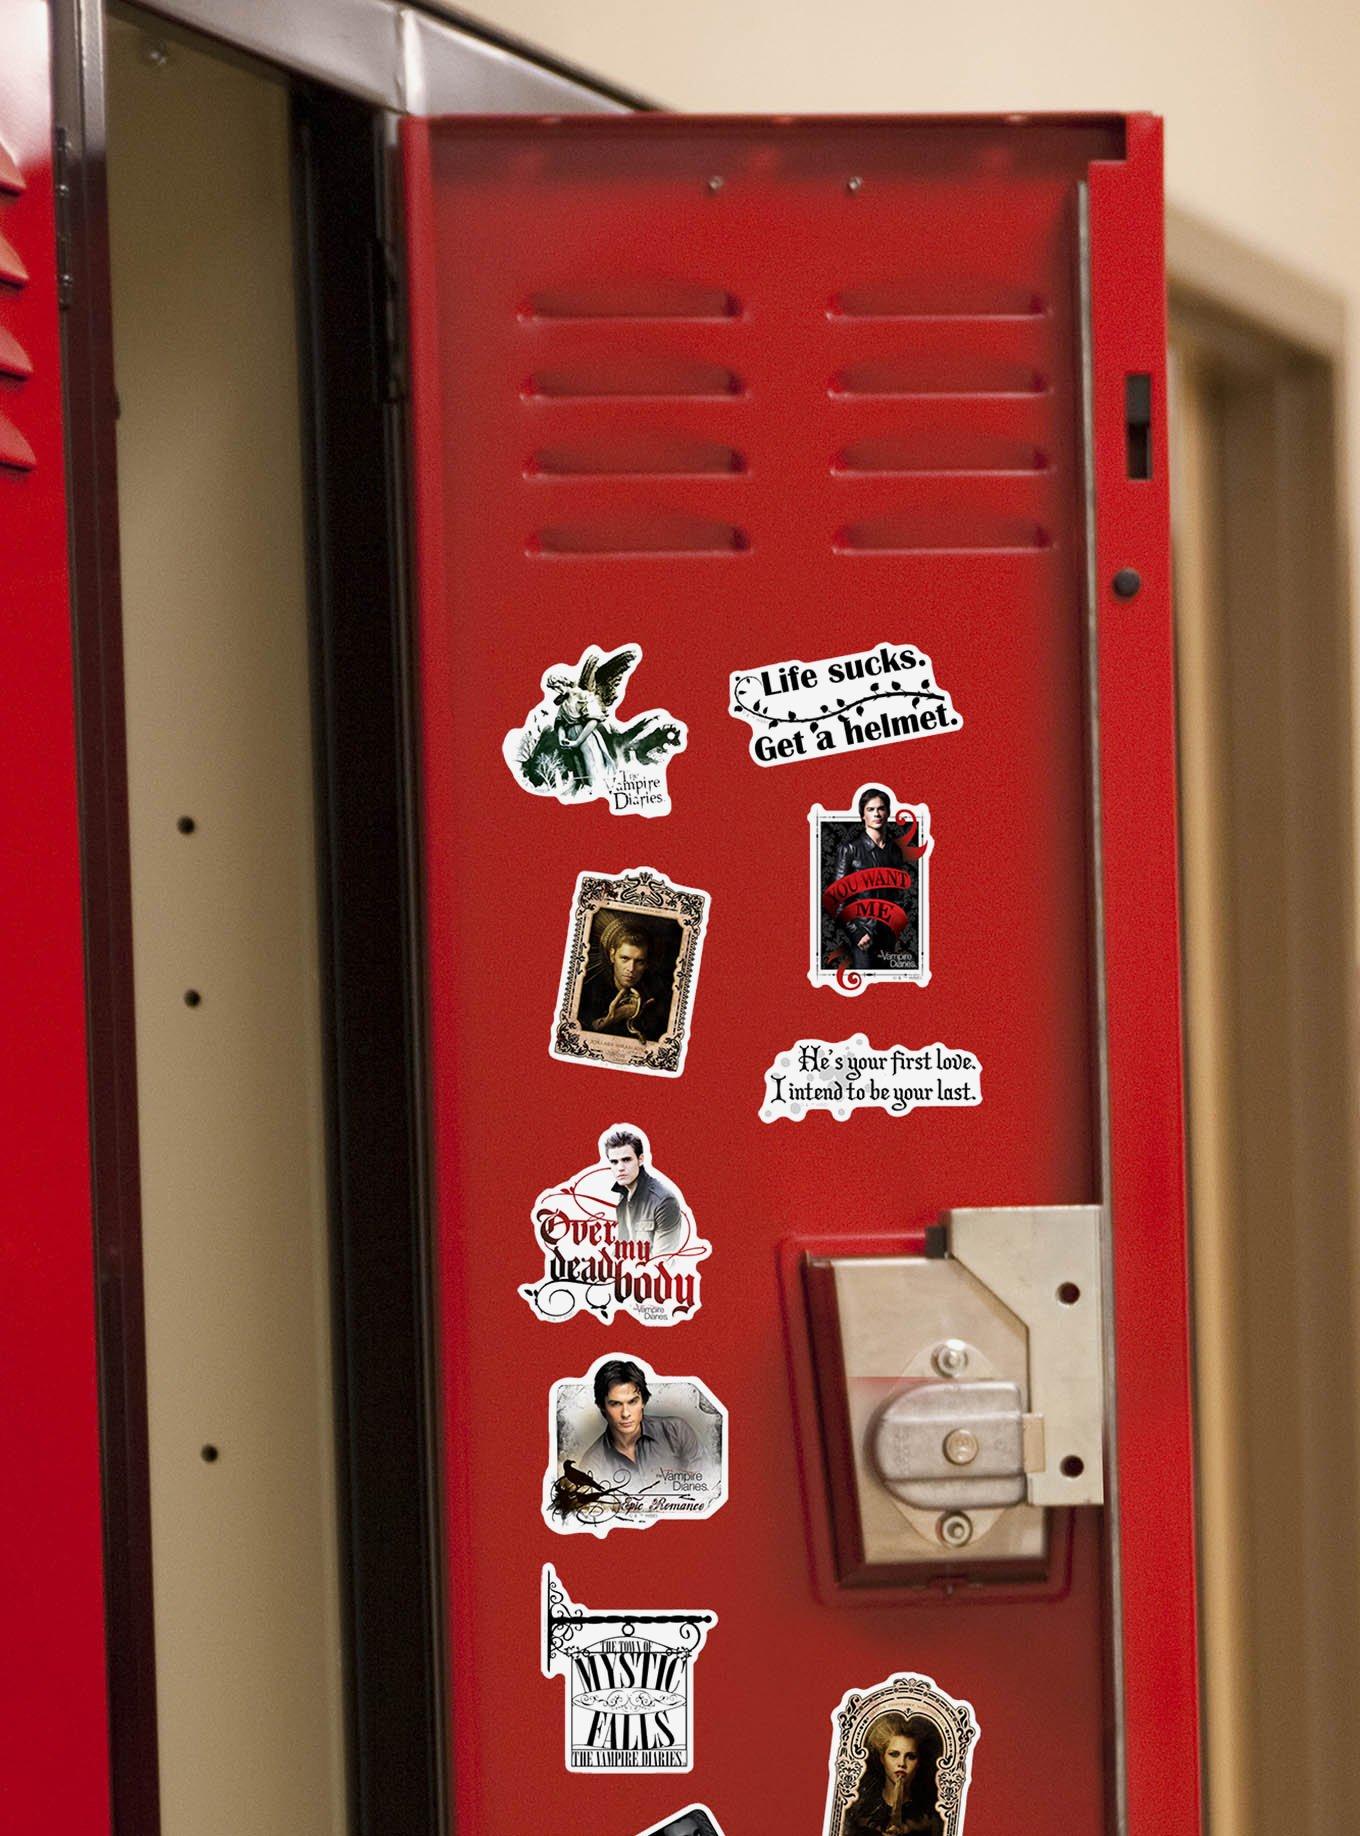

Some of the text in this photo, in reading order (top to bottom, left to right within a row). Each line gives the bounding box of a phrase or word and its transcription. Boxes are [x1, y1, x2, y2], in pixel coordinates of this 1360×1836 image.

[761, 648, 926, 696] Life sucks.
[754, 703, 958, 761] Get a helmet.
[828, 869, 909, 901] YOU WANT
[856, 902, 893, 922] ME
[798, 1045, 977, 1081] He's your first love.
[770, 1074, 977, 1111] I intend to be your last.
[536, 1208, 651, 1268] Over my
[549, 1246, 695, 1318] dead body
[660, 1467, 703, 1480] Vampire
[649, 1497, 705, 1511] Romance
[601, 1641, 617, 1653] THE
[643, 1640, 653, 1653] OF
[574, 1652, 687, 1693] MYSTIC
[586, 1711, 675, 1750] FALLS
[573, 1751, 682, 1766] THE VAMPIRE DIARIES
